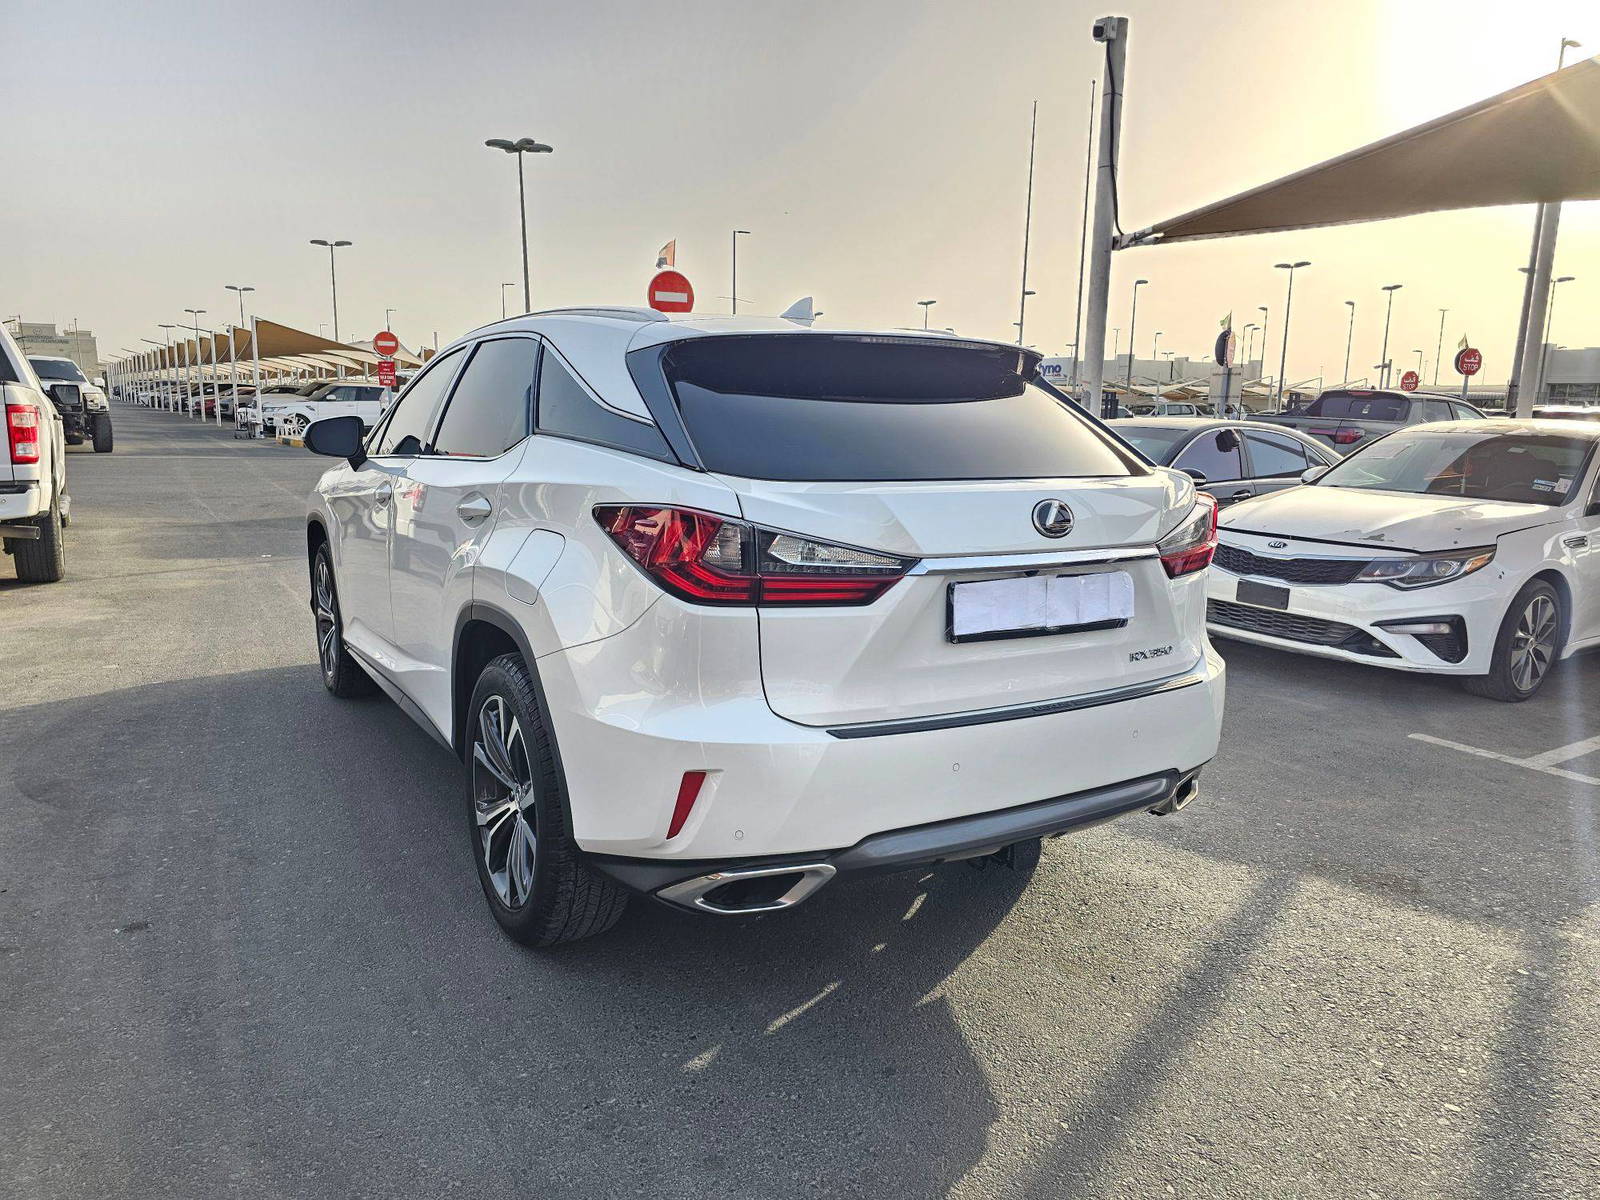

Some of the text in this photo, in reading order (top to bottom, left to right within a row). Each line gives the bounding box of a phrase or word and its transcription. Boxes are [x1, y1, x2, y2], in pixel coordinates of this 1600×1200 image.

[1039, 363, 1062, 377] yno
[1463, 363, 1479, 371] STOP
[1269, 541, 1286, 549] KIA
[1129, 650, 1149, 662] RX
